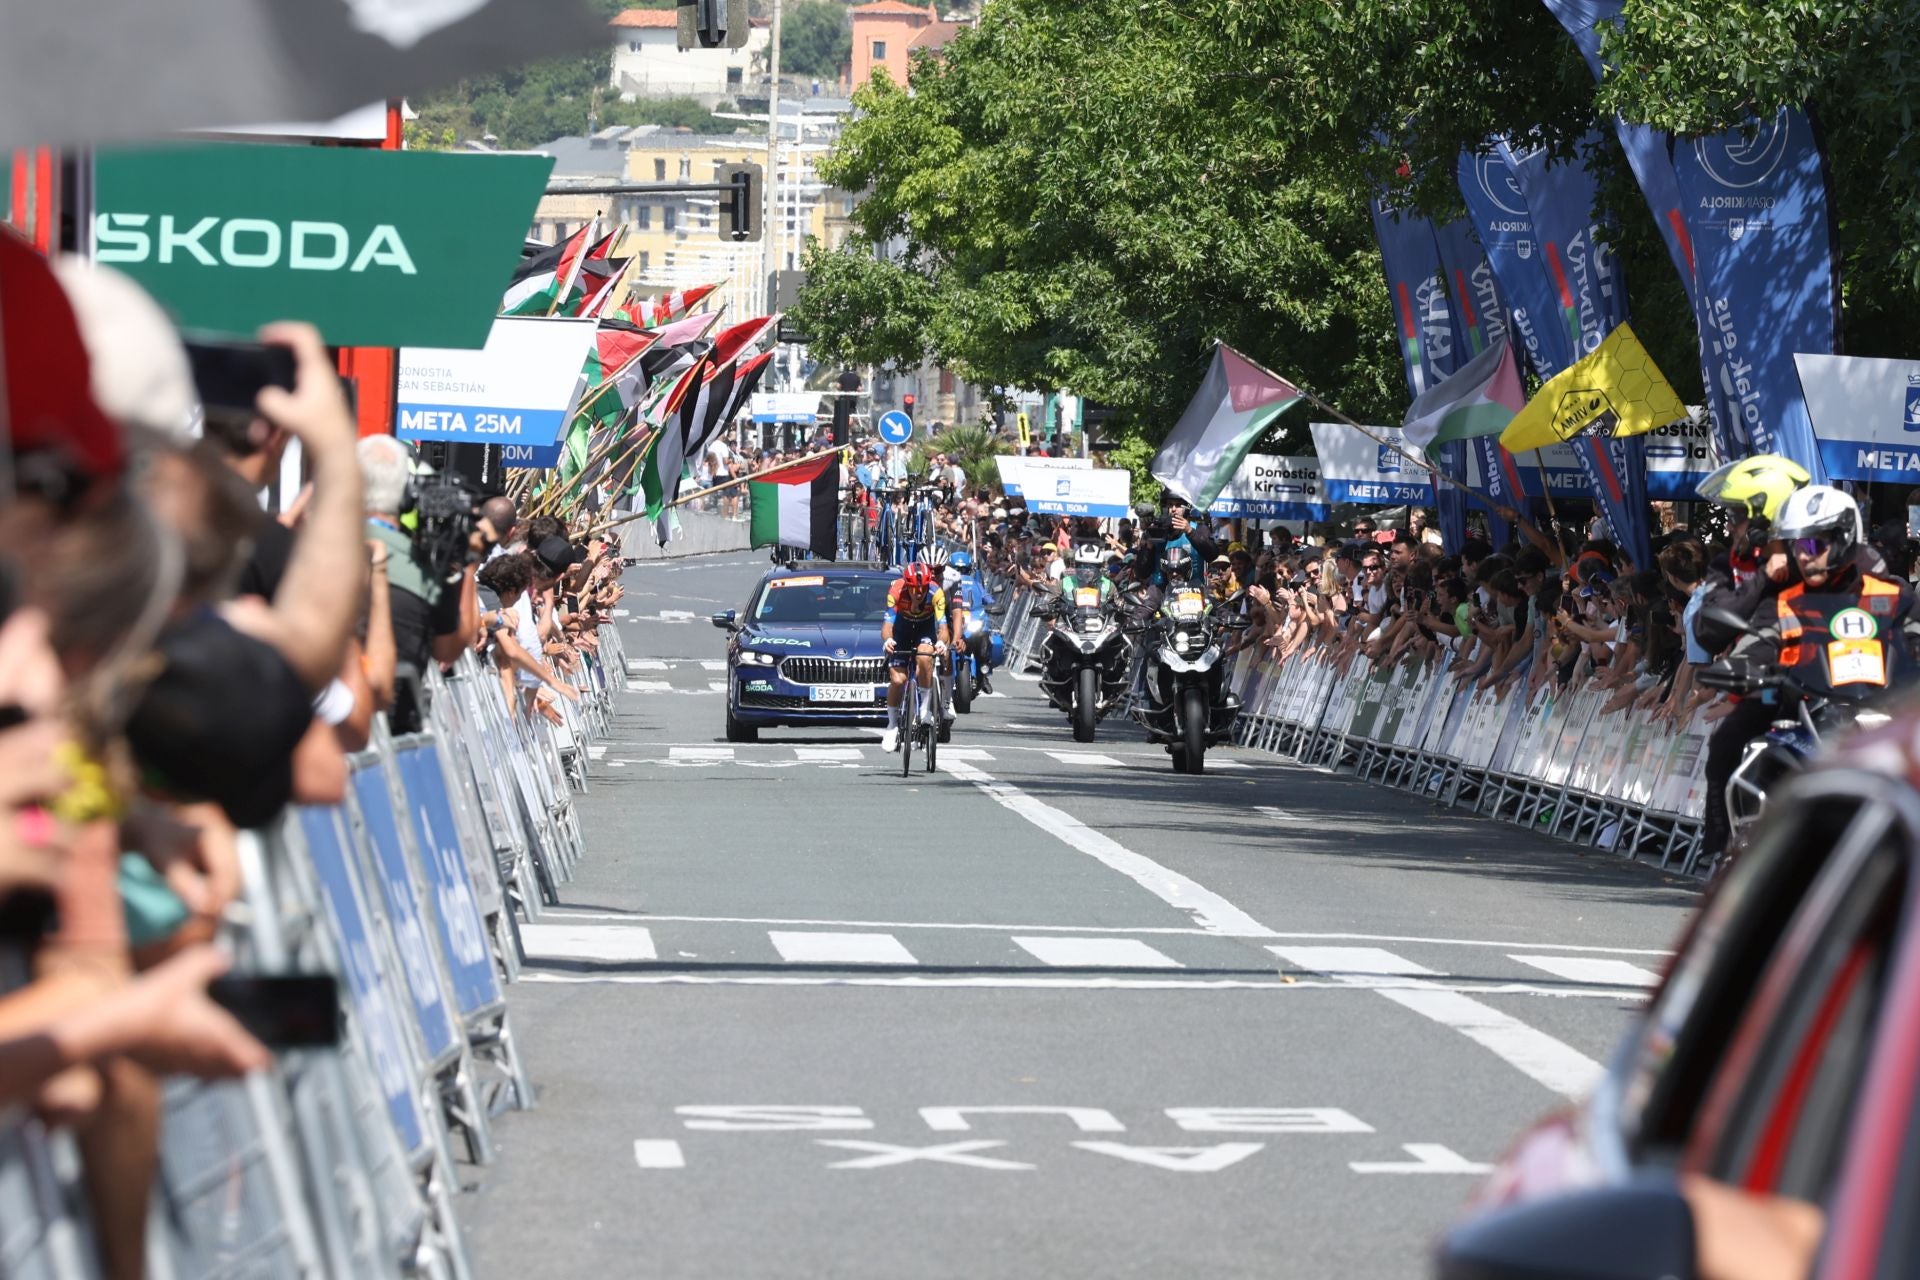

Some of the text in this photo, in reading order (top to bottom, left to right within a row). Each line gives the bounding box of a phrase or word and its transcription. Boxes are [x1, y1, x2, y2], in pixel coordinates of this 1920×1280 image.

[401, 410, 521, 434] META 25M
[1255, 467, 1316, 480] Donostia
[1348, 485, 1424, 500] META 75M
[1039, 502, 1088, 513] META 150M
[1246, 503, 1275, 514] 100M
[1842, 616, 1865, 635] H
[817, 689, 872, 699] 5572 MYT
